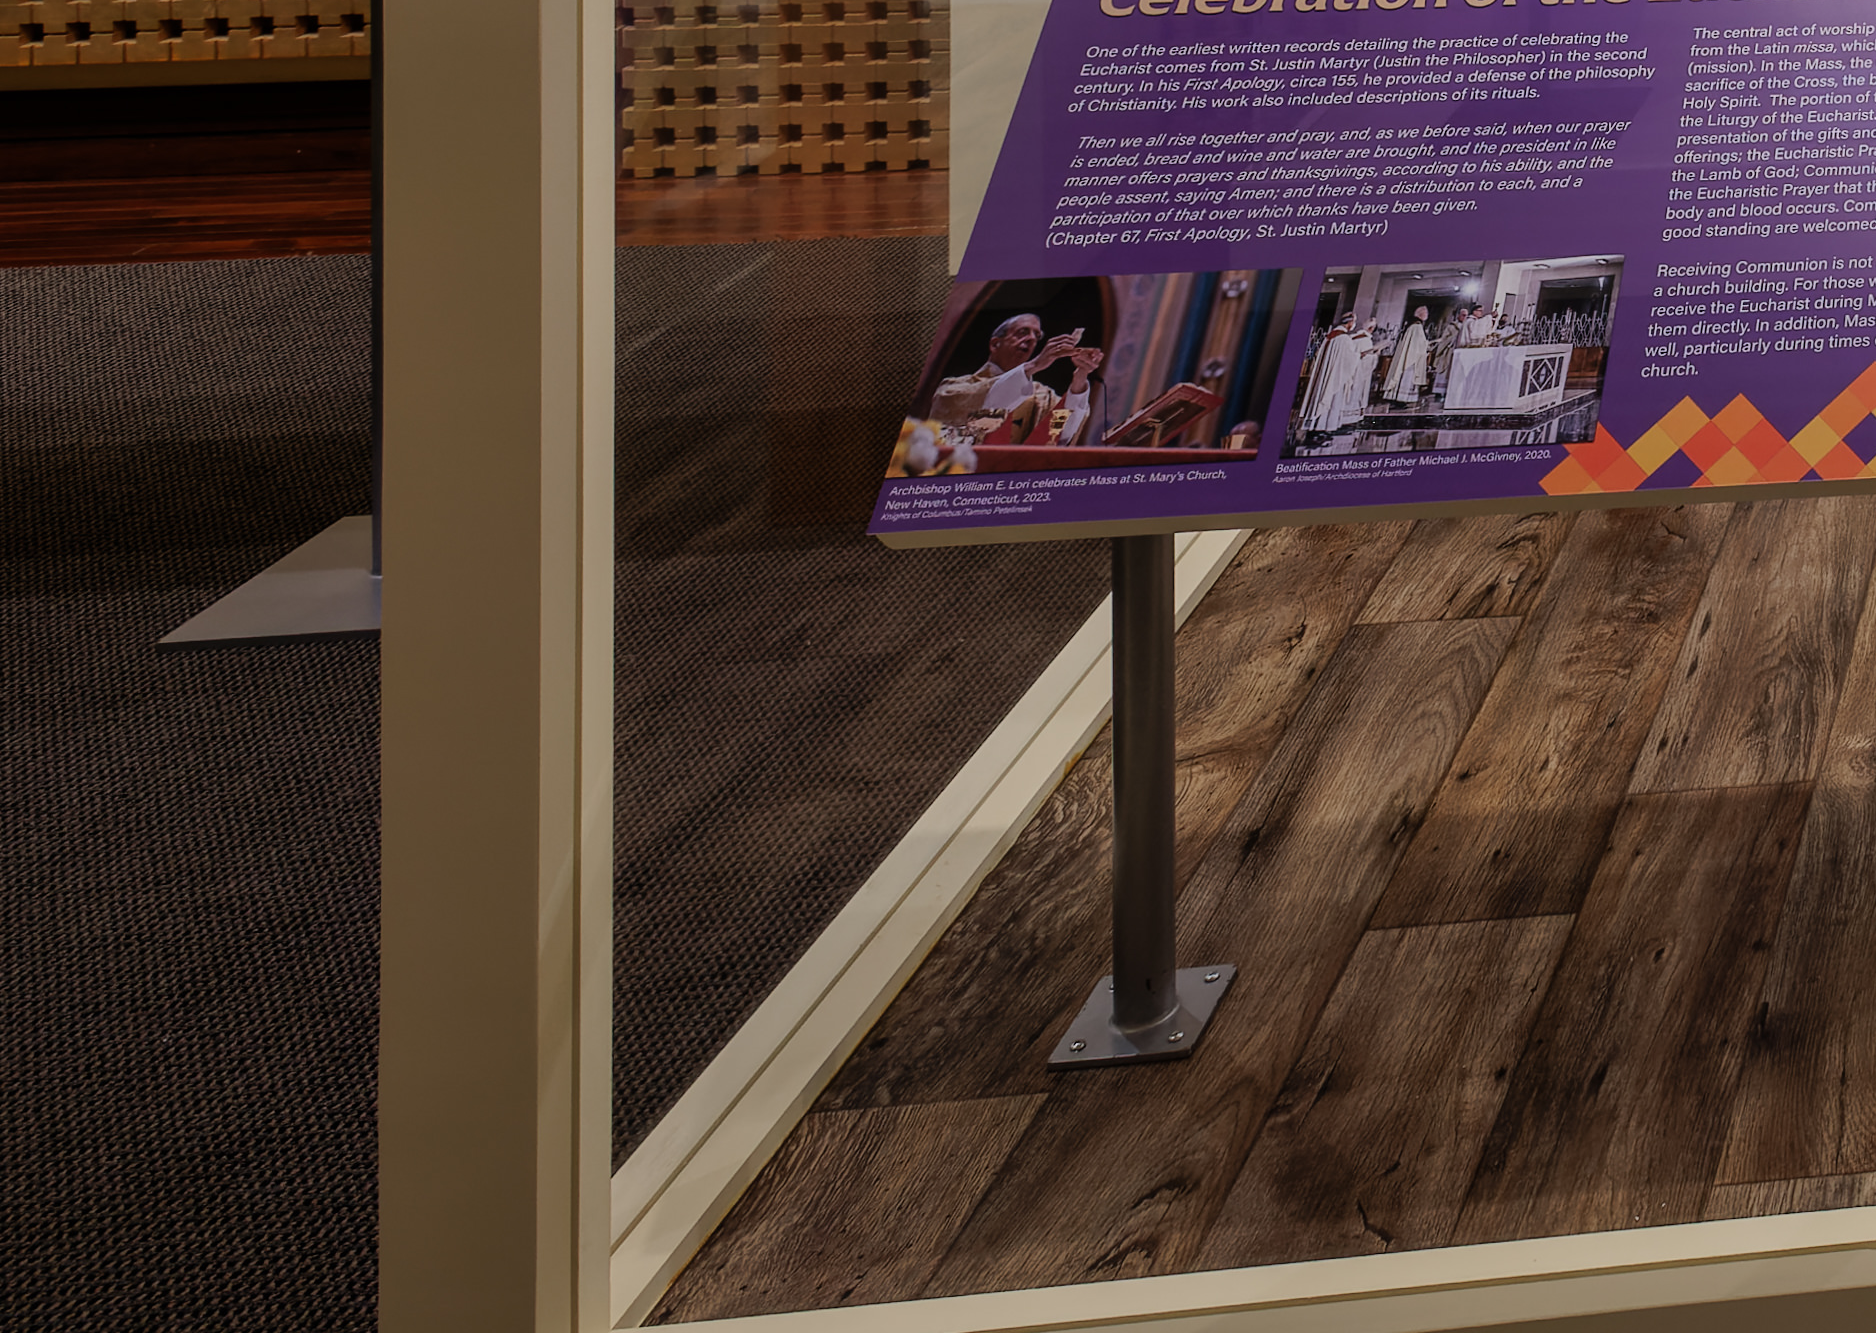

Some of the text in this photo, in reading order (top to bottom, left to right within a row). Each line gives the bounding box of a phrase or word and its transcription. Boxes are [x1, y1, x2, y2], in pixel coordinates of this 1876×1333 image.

[1694, 26, 1720, 39] The
[1723, 24, 1771, 38] central
[1775, 24, 1798, 37] act
[1801, 23, 1816, 36] of
[1819, 22, 1875, 38] worship
[1086, 31, 1628, 58] One of the earliest written records detailing the practice of celebrating the
[1275, 461, 1339, 473] Beatification
[1341, 459, 1369, 470] Mass
[1370, 458, 1382, 468] of
[1383, 456, 1416, 468] Father
[1418, 454, 1458, 466] Michael
[1470, 451, 1522, 465] McGivney,
